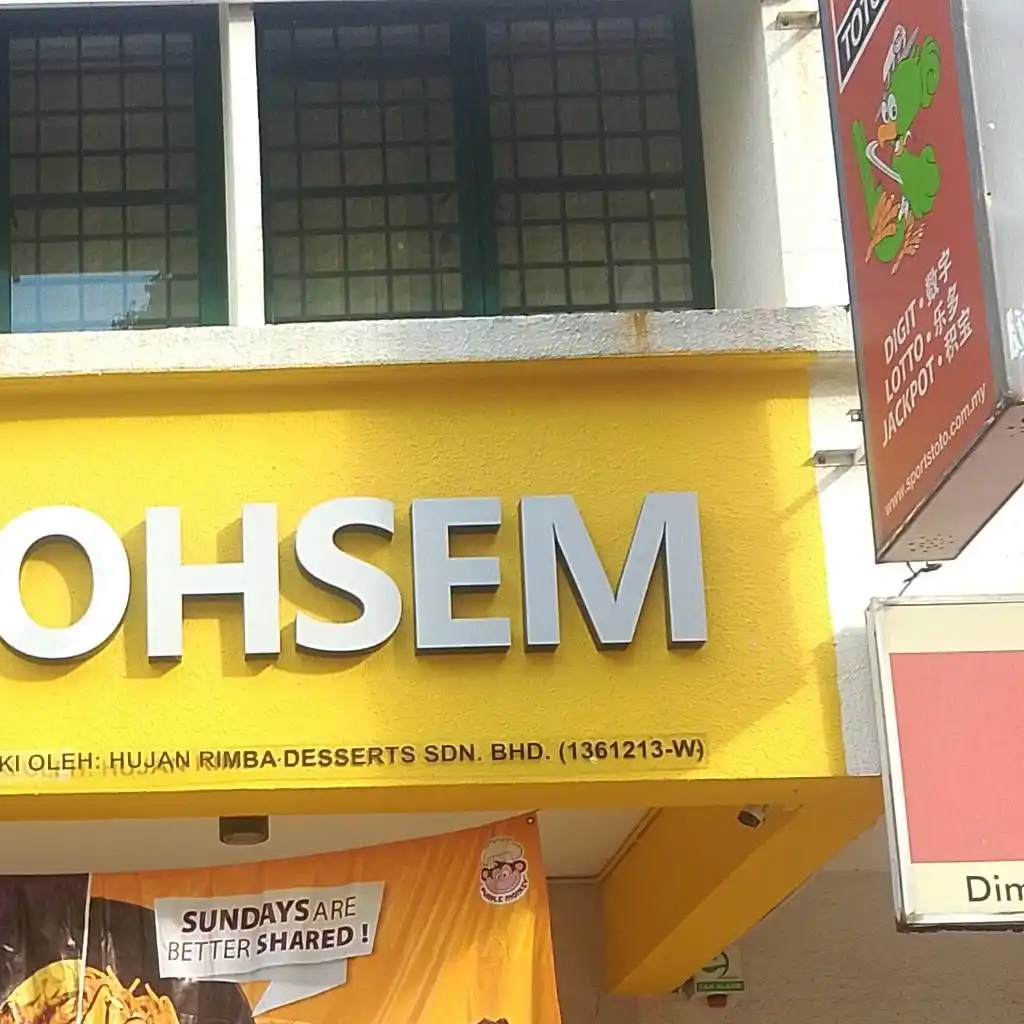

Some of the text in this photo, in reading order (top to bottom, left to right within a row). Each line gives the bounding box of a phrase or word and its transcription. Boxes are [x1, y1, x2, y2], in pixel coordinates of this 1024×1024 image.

[841, 0, 880, 61] TOT
[884, 299, 916, 365] DIGIT
[884, 334, 924, 404] LOTTO
[883, 356, 935, 447] JACKPOT
[884, 383, 986, 516] www.sportstoto.com.my
[28, 752, 100, 772] OLEH:
[110, 750, 190, 770] HUJAN
[200, 749, 277, 769] RIMBA
[283, 745, 415, 768] DESSERTS
[424, 744, 482, 763] SDN.
[491, 743, 550, 762] BHD.
[559, 738, 705, 763] (1361213-W)
[168, 938, 250, 962] BETTER
[257, 926, 354, 954] SHARED
[182, 896, 356, 933] SUNDAYS ARE
